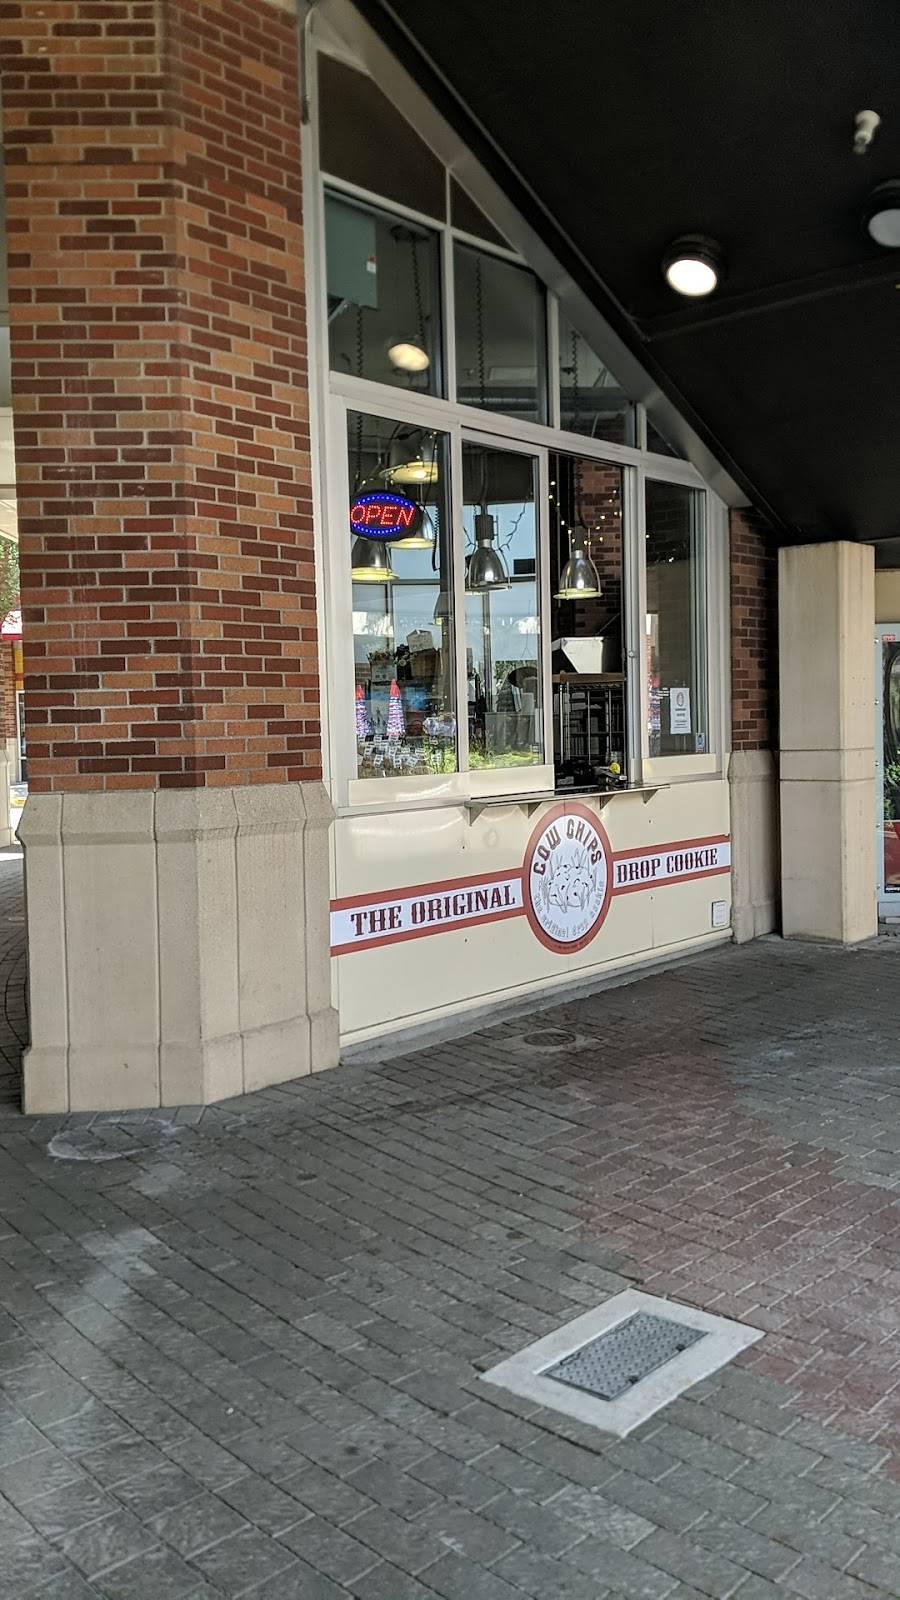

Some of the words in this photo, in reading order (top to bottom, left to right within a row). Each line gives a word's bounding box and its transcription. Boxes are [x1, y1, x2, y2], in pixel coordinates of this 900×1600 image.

[351, 505, 415, 526] OPEN
[533, 826, 561, 876] COW
[566, 818, 602, 866] CHIPS
[617, 858, 660, 883] DROP
[666, 848, 718, 874] COOKIE
[350, 906, 402, 937] THE
[411, 885, 516, 925] ORIGINAL
